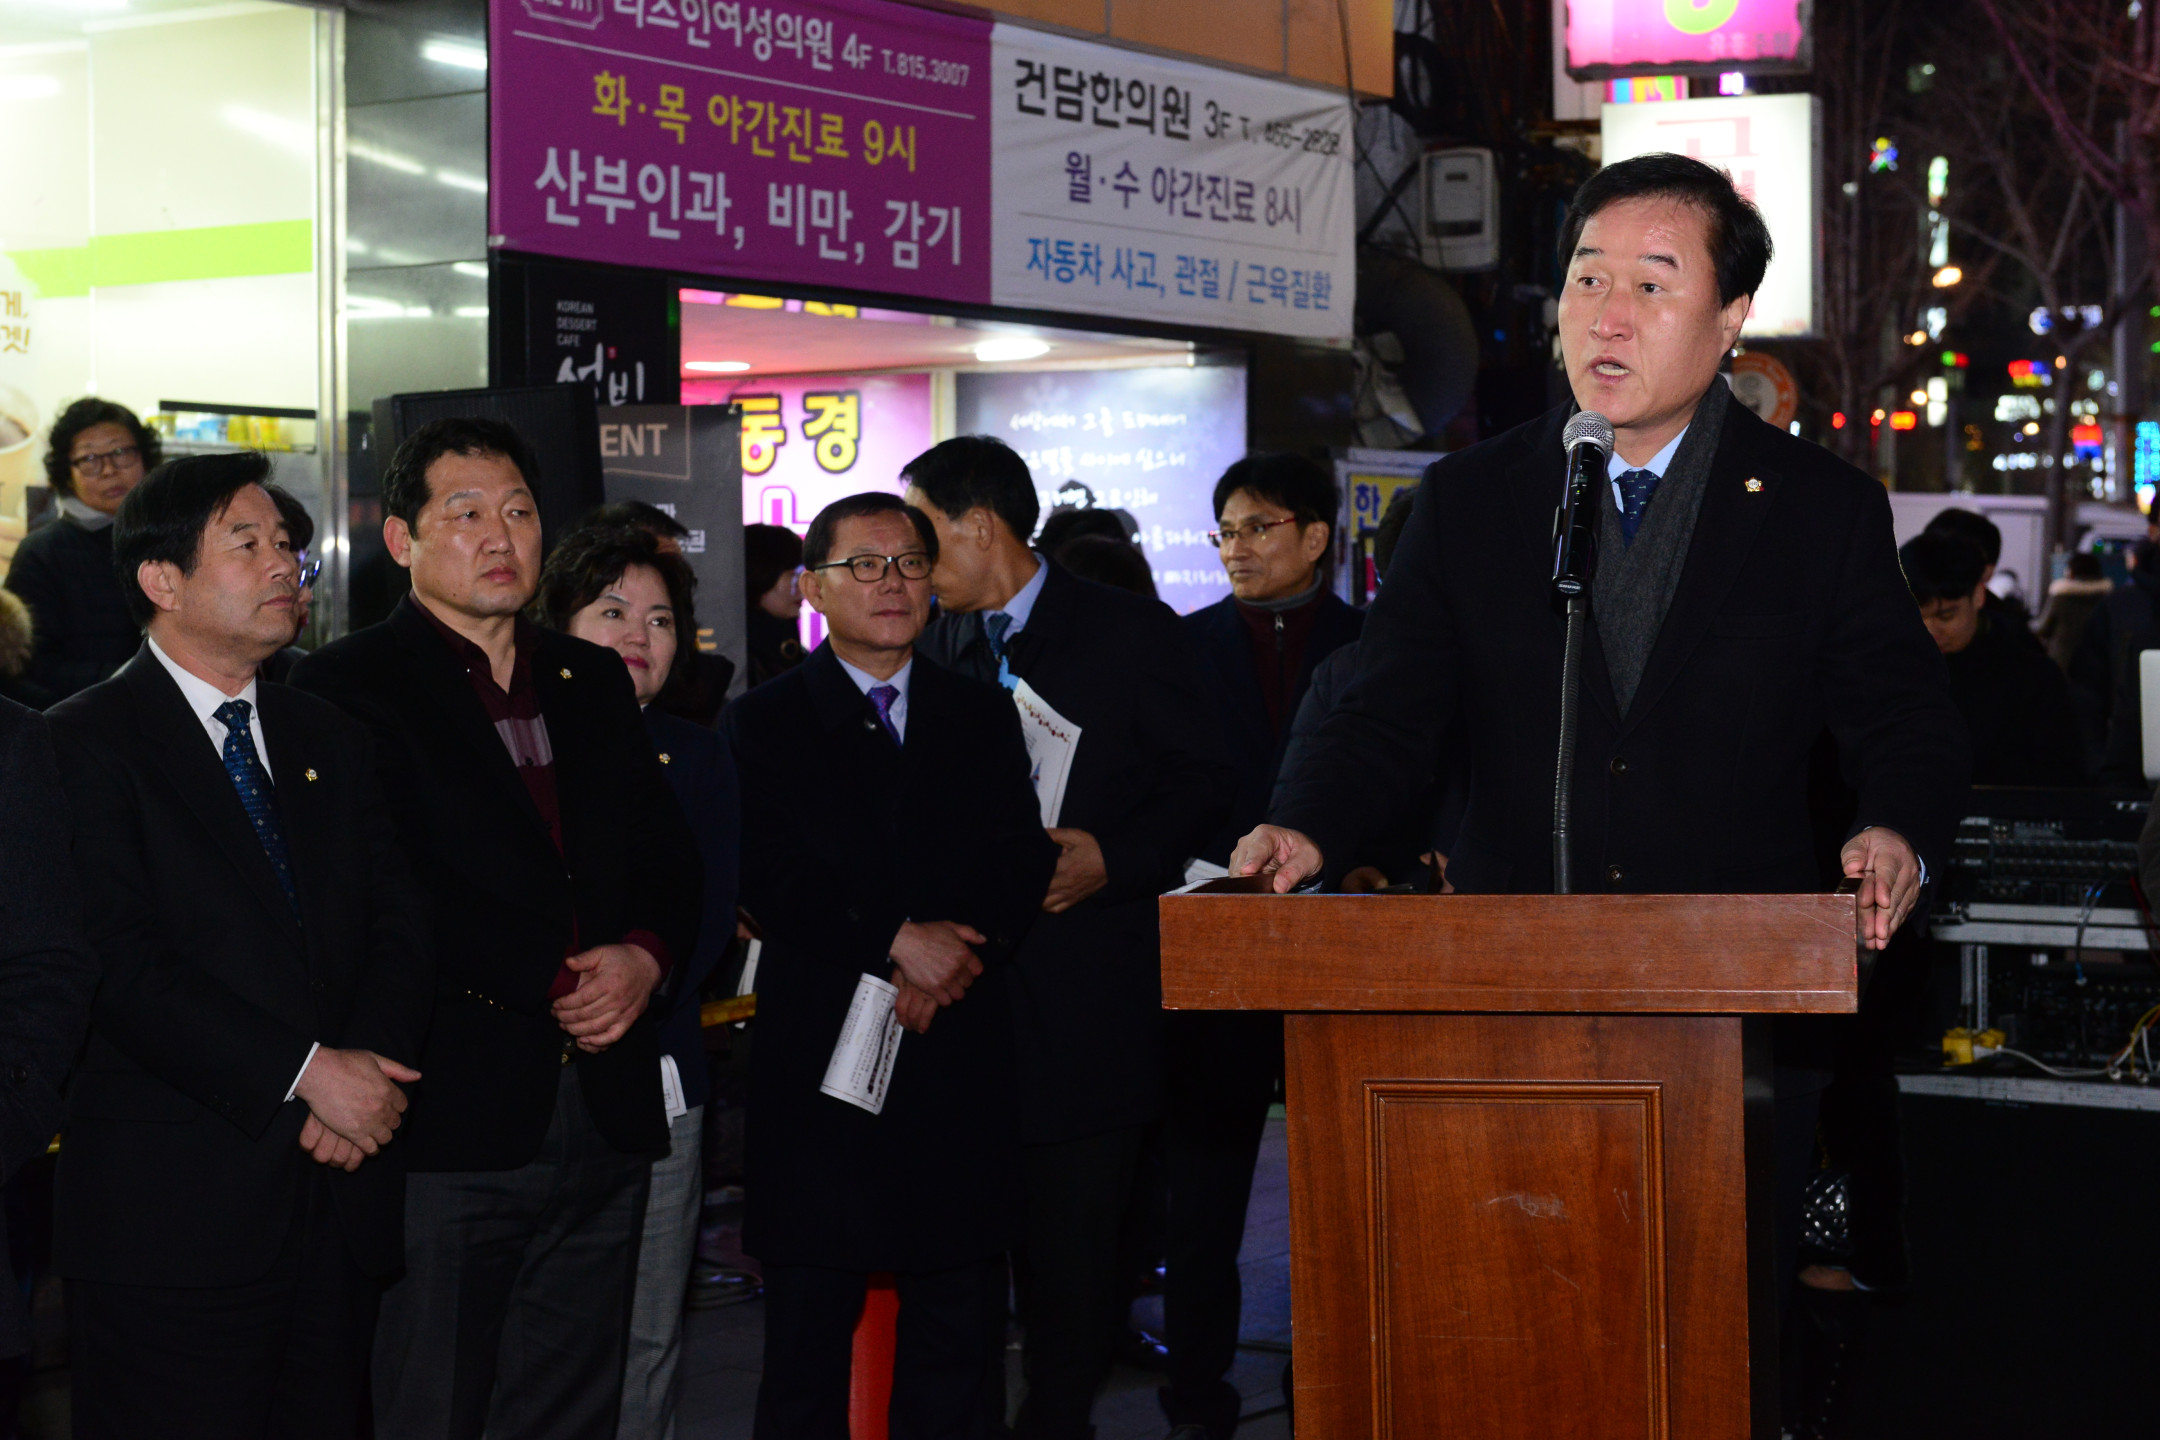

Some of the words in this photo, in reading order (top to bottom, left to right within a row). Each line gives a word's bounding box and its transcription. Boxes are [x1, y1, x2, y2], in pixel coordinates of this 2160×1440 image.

[841, 32, 874, 70] 4F
[592, 70, 692, 144] 화·목
[707, 94, 850, 163] 야간진료
[863, 120, 917, 173] 9시
[1015, 59, 1191, 141] 건담한의원
[1204, 100, 1231, 139] 3F
[534, 147, 745, 250] 산부인과,
[768, 183, 866, 264] 비만,
[883, 200, 962, 270] 감기
[1065, 150, 1140, 209] 월·수
[1152, 166, 1256, 224] 야간진료
[1266, 186, 1302, 234] 8시
[556, 300, 594, 314] KOREAN
[1027, 237, 1102, 286] 자동차
[1111, 248, 1166, 298] 사고,
[1175, 254, 1220, 299] 관절
[1247, 263, 1332, 311] 근육질환
